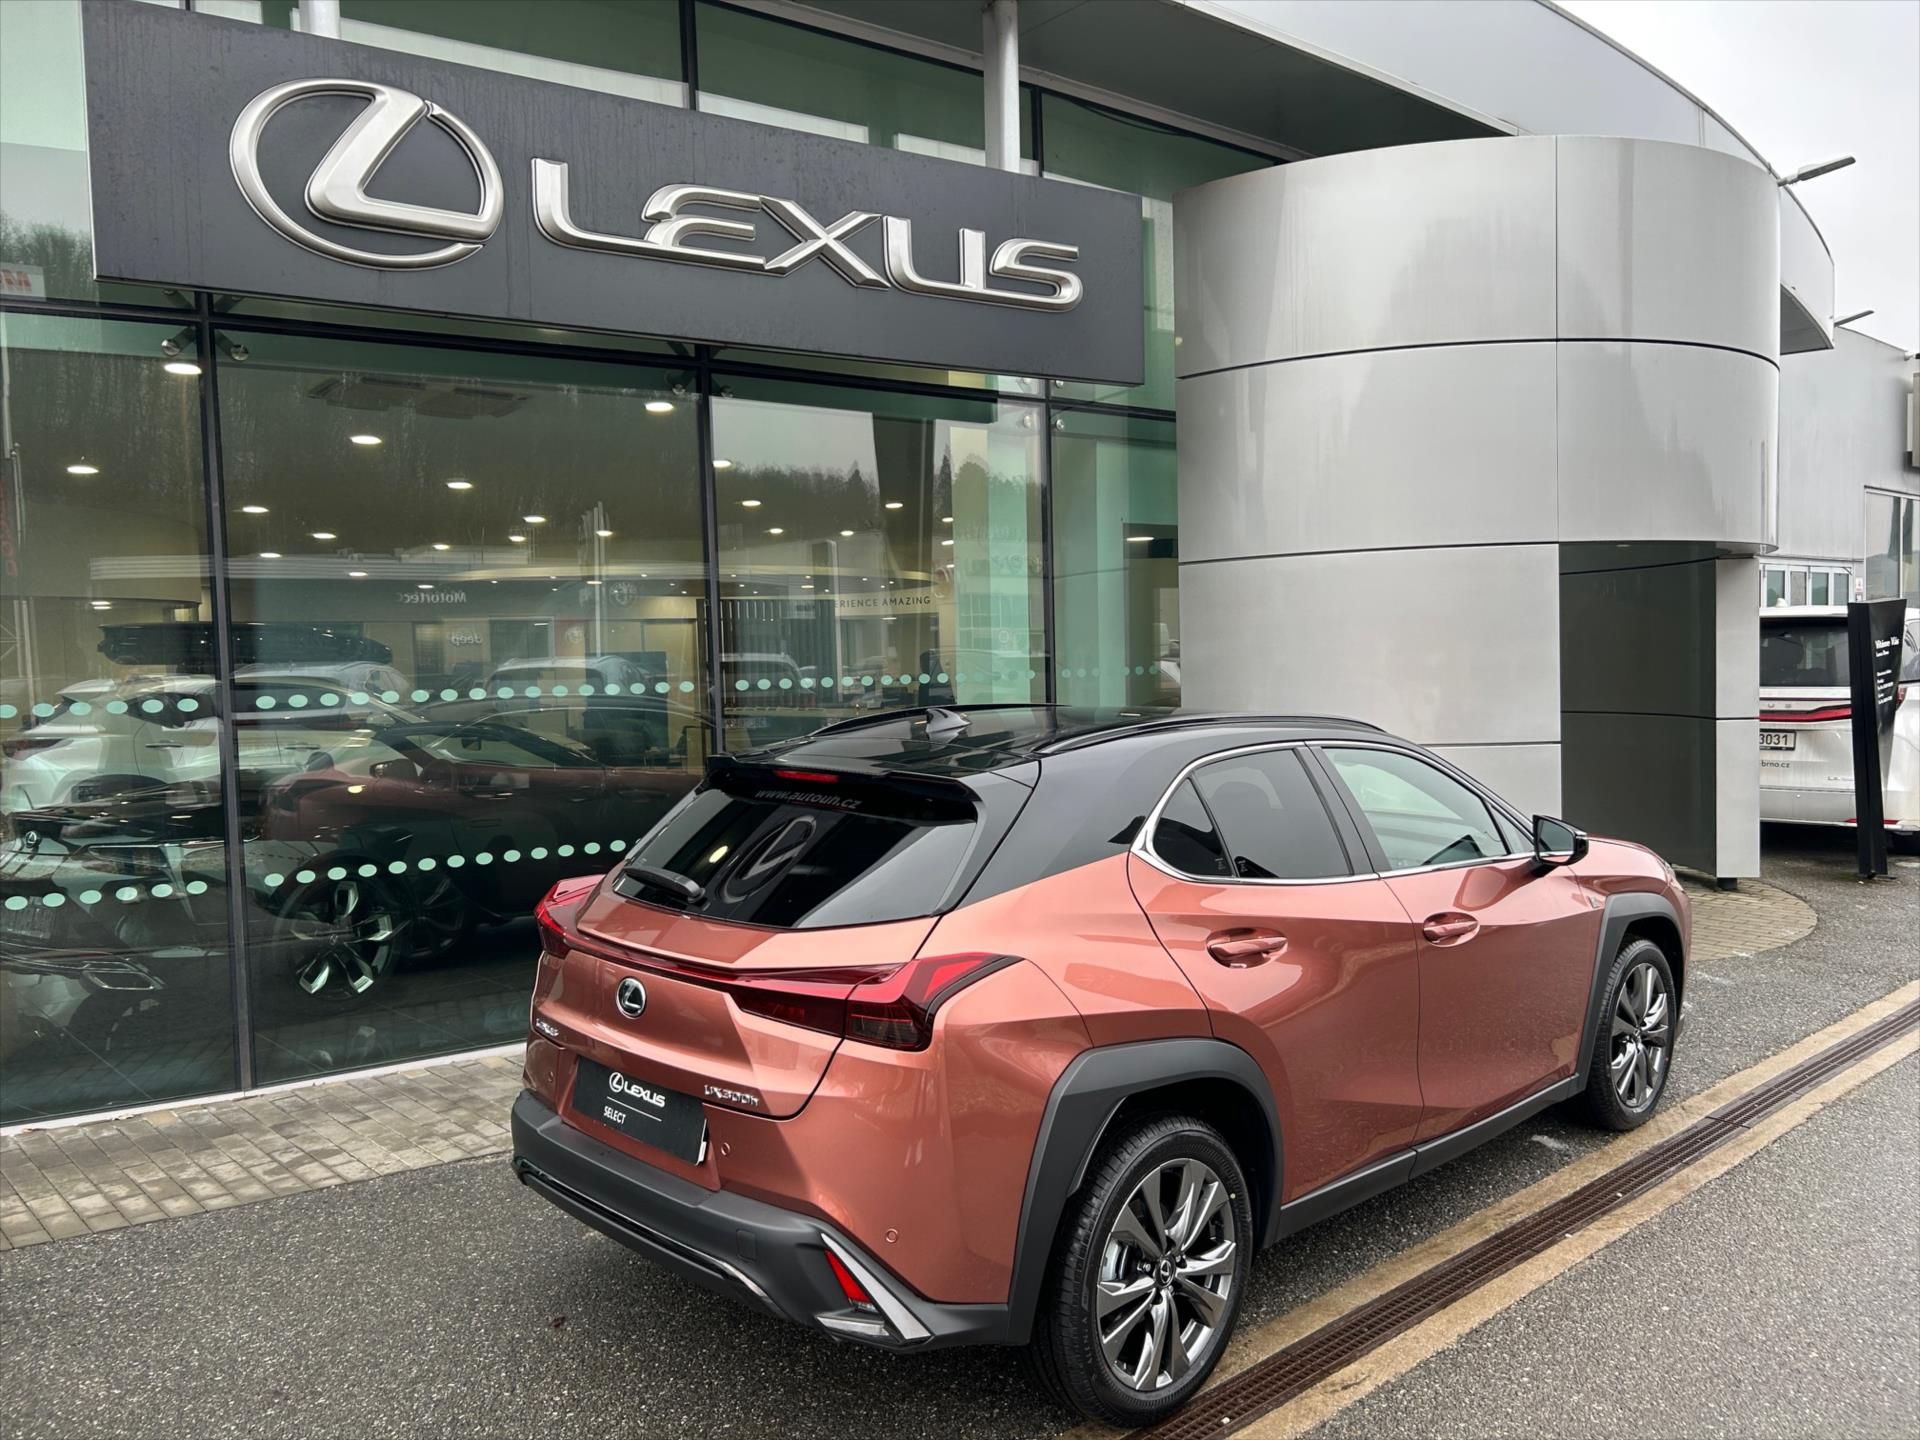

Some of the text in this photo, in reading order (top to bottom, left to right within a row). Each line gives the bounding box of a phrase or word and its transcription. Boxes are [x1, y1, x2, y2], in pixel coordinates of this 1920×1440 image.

[531, 157, 1083, 313] LEXUS
[834, 596, 931, 609] ERIENCE AMAZING
[1760, 760, 1790, 768] brno.cz
[624, 1080, 666, 1108] LEXUS
[603, 1105, 626, 1125] SELECT
